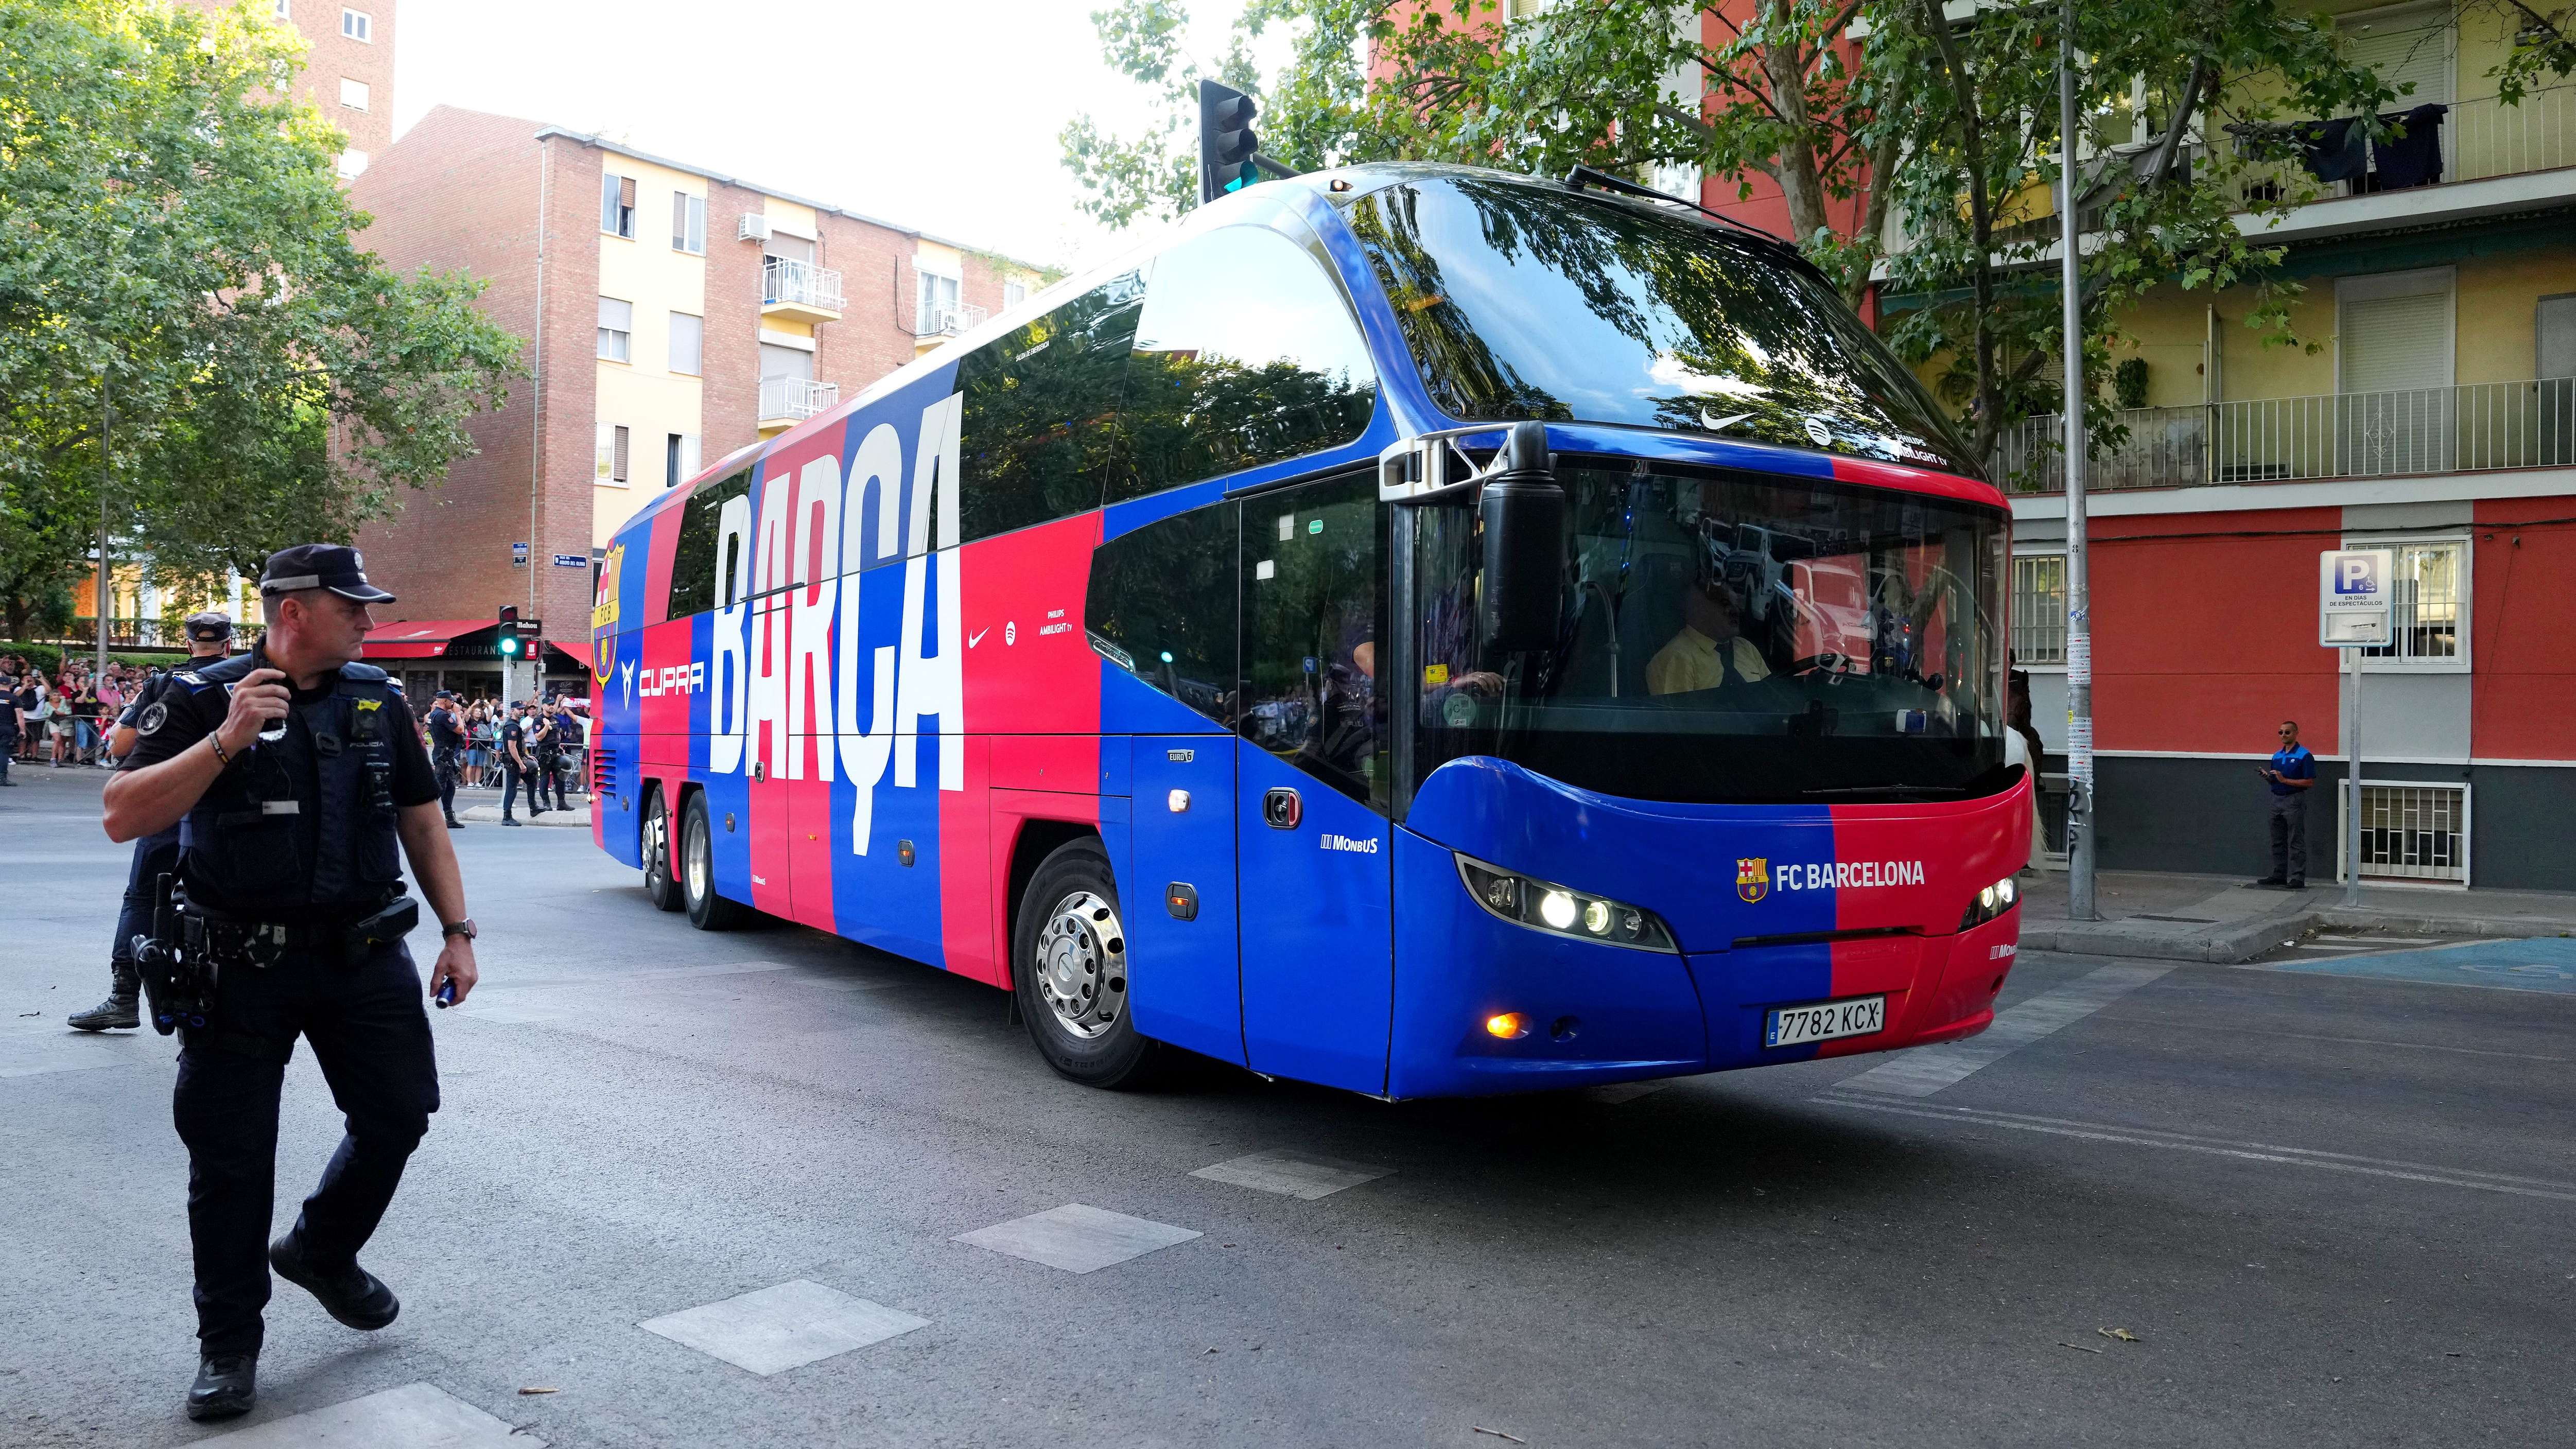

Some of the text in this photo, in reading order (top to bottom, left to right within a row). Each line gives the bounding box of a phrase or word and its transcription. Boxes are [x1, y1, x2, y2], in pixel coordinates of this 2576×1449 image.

[1895, 433, 1926, 447] PHILIPS
[1894, 443, 1937, 463] MBILIGHT
[2343, 560, 2370, 590] P
[710, 390, 963, 857] BARÇA
[1048, 609, 1065, 619] PHILIPS
[1039, 622, 1072, 636] AMBILIGHT tv
[639, 661, 704, 697] CUPRA
[1187, 752, 1192, 760] 6
[1777, 861, 1925, 891] FC BARCELONA
[1782, 1002, 1878, 1040] 7782 KCX
